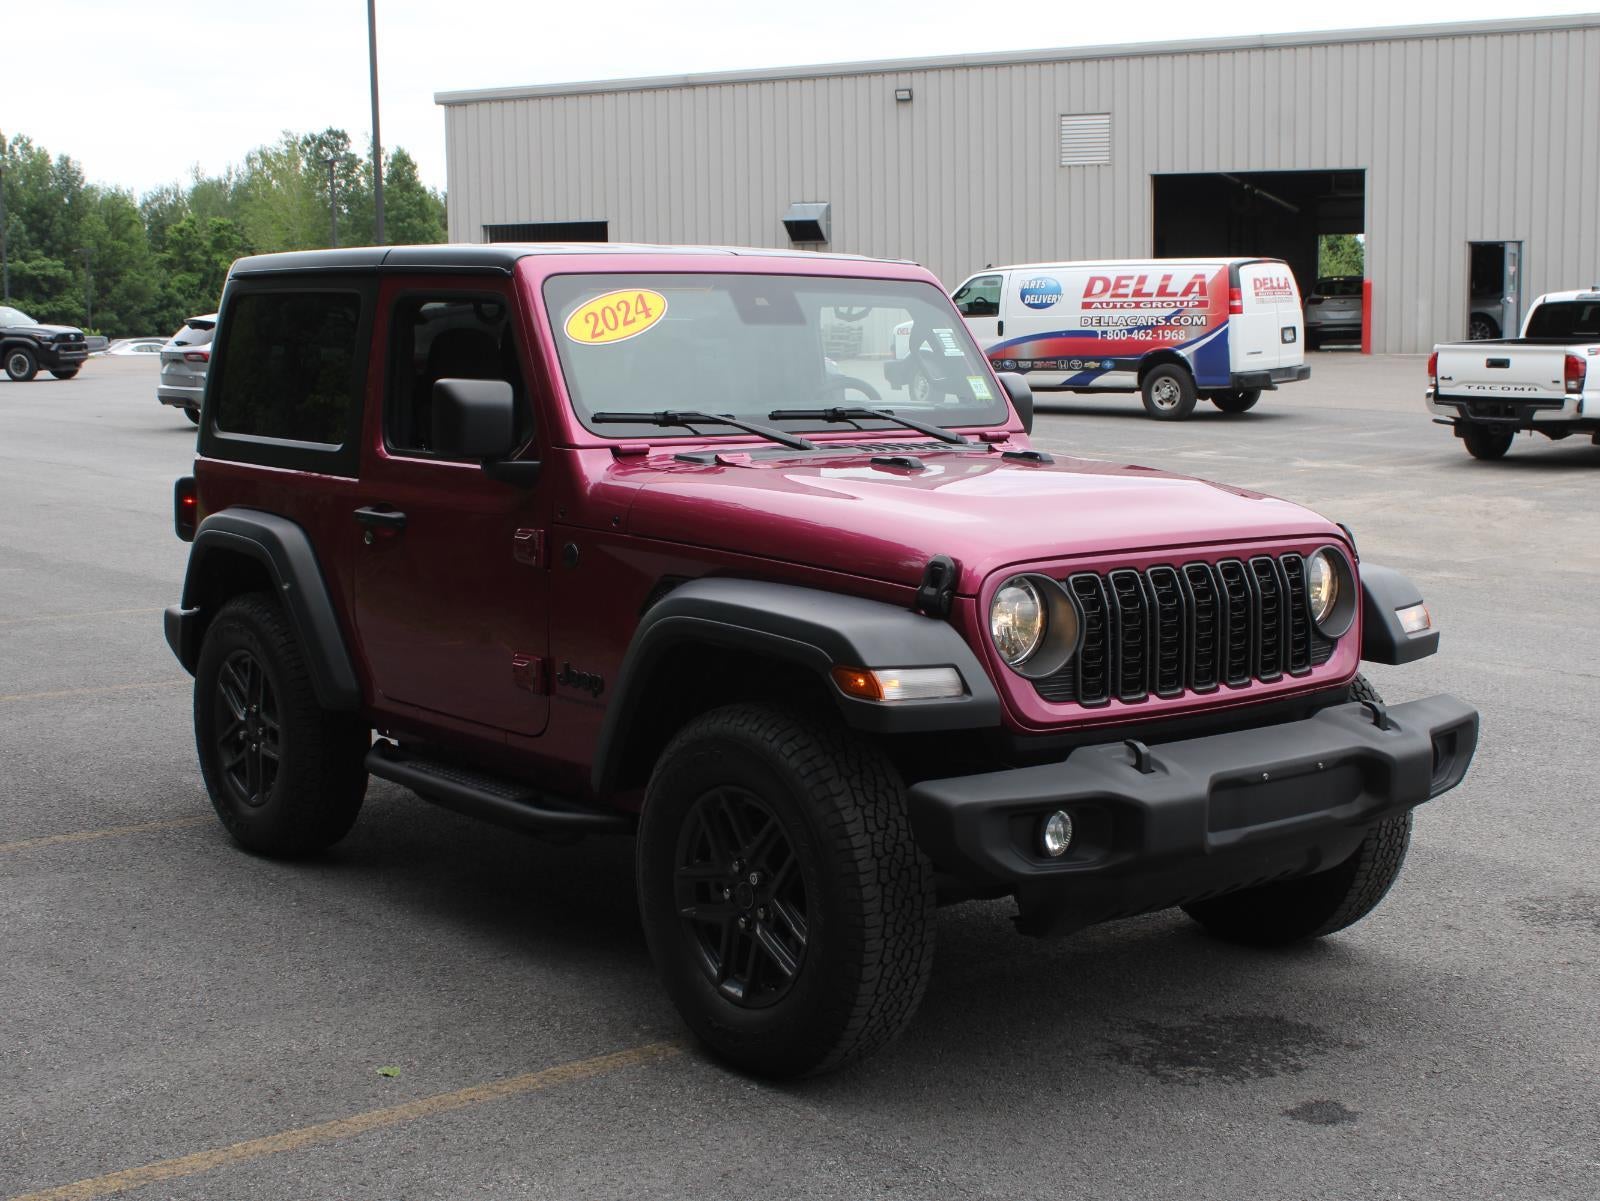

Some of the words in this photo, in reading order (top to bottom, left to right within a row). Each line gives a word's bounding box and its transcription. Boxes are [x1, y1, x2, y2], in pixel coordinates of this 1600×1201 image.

[1020, 280, 1046, 289] PARTS
[1083, 274, 1208, 298] DELLA
[1253, 277, 1291, 290] DELLA
[1024, 294, 1063, 304] DELIVERY
[584, 293, 652, 339] 2024
[1080, 315, 1207, 327] DELLACARS.COM
[1097, 329, 1185, 340] 1-800-462-1968
[556, 661, 604, 698] Jeep
